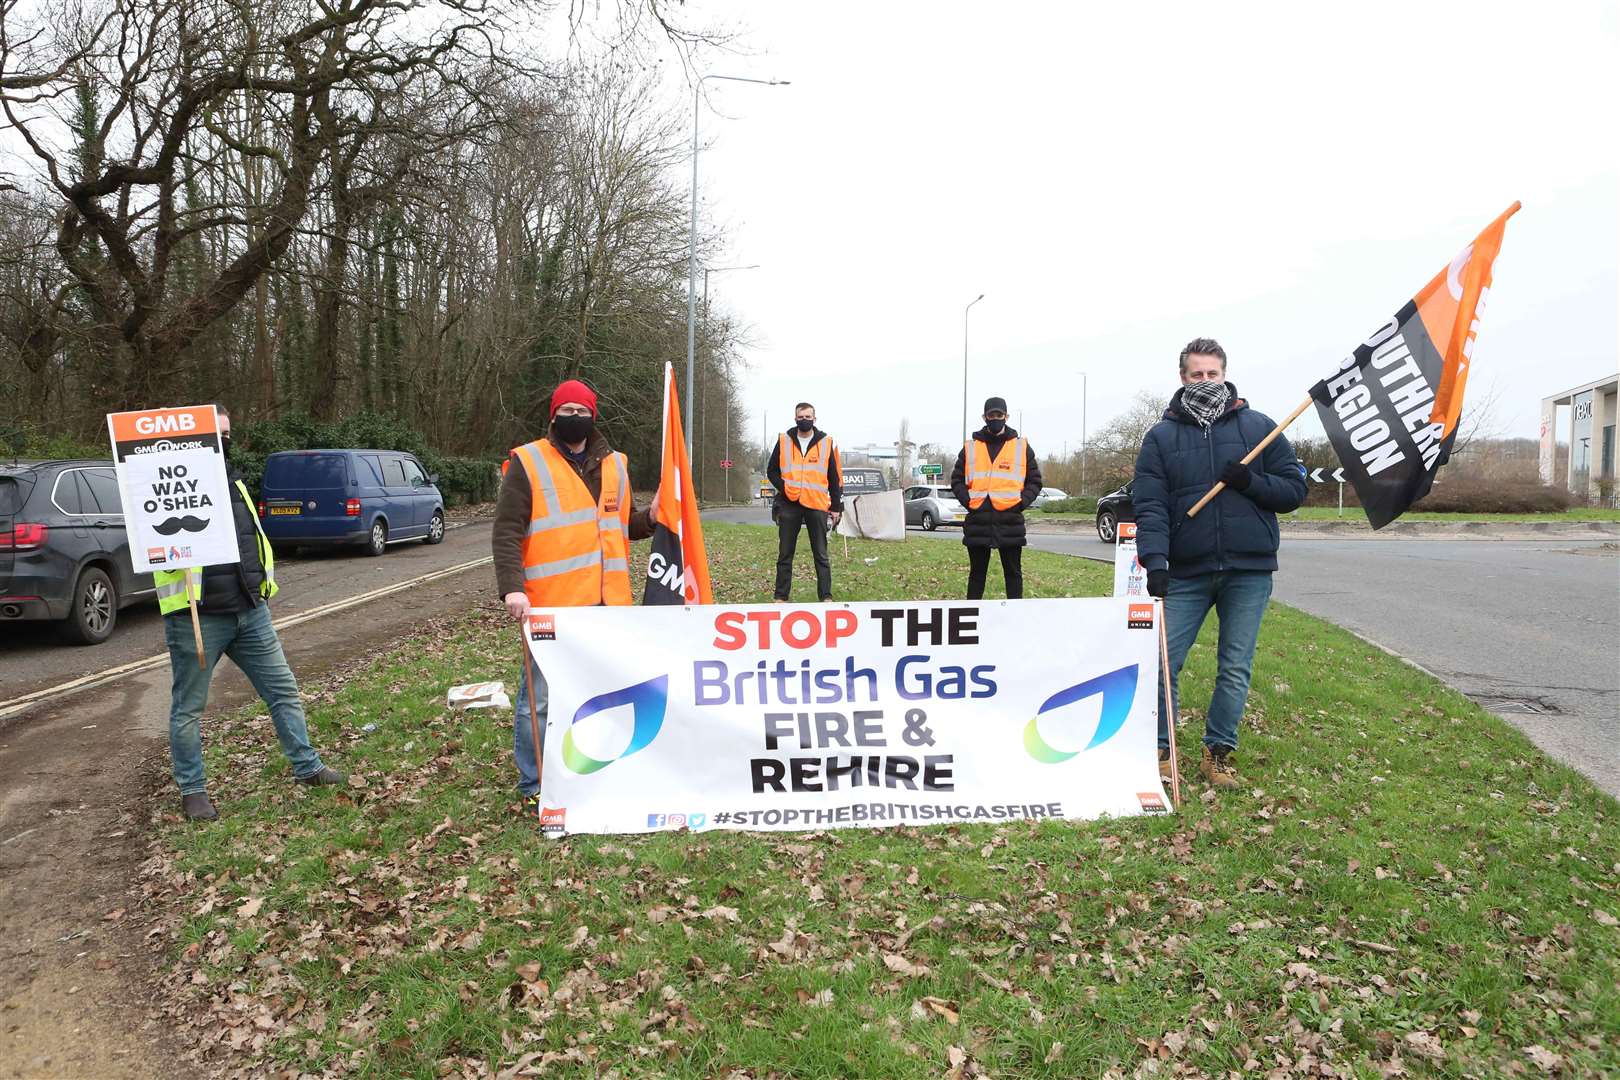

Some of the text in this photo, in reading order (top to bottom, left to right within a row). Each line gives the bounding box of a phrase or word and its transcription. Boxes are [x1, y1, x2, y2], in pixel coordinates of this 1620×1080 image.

[1366, 315, 1446, 472] OUTHERN
[1574, 400, 1593, 420] next
[135, 413, 196, 434] GMB
[158, 465, 188, 480] NO
[842, 475, 865, 484] BAXI
[152, 479, 198, 497] WAY
[143, 494, 213, 513] O'SHEA
[1131, 610, 1152, 619] GMB
[532, 622, 553, 630] GMB
[713, 607, 980, 651] STOP THE
[693, 655, 998, 706] British Gas
[764, 708, 937, 751] FIRE &
[750, 754, 955, 794] REHIRE
[714, 803, 1065, 825] #STOPTHEBRITISHGASFIRE
